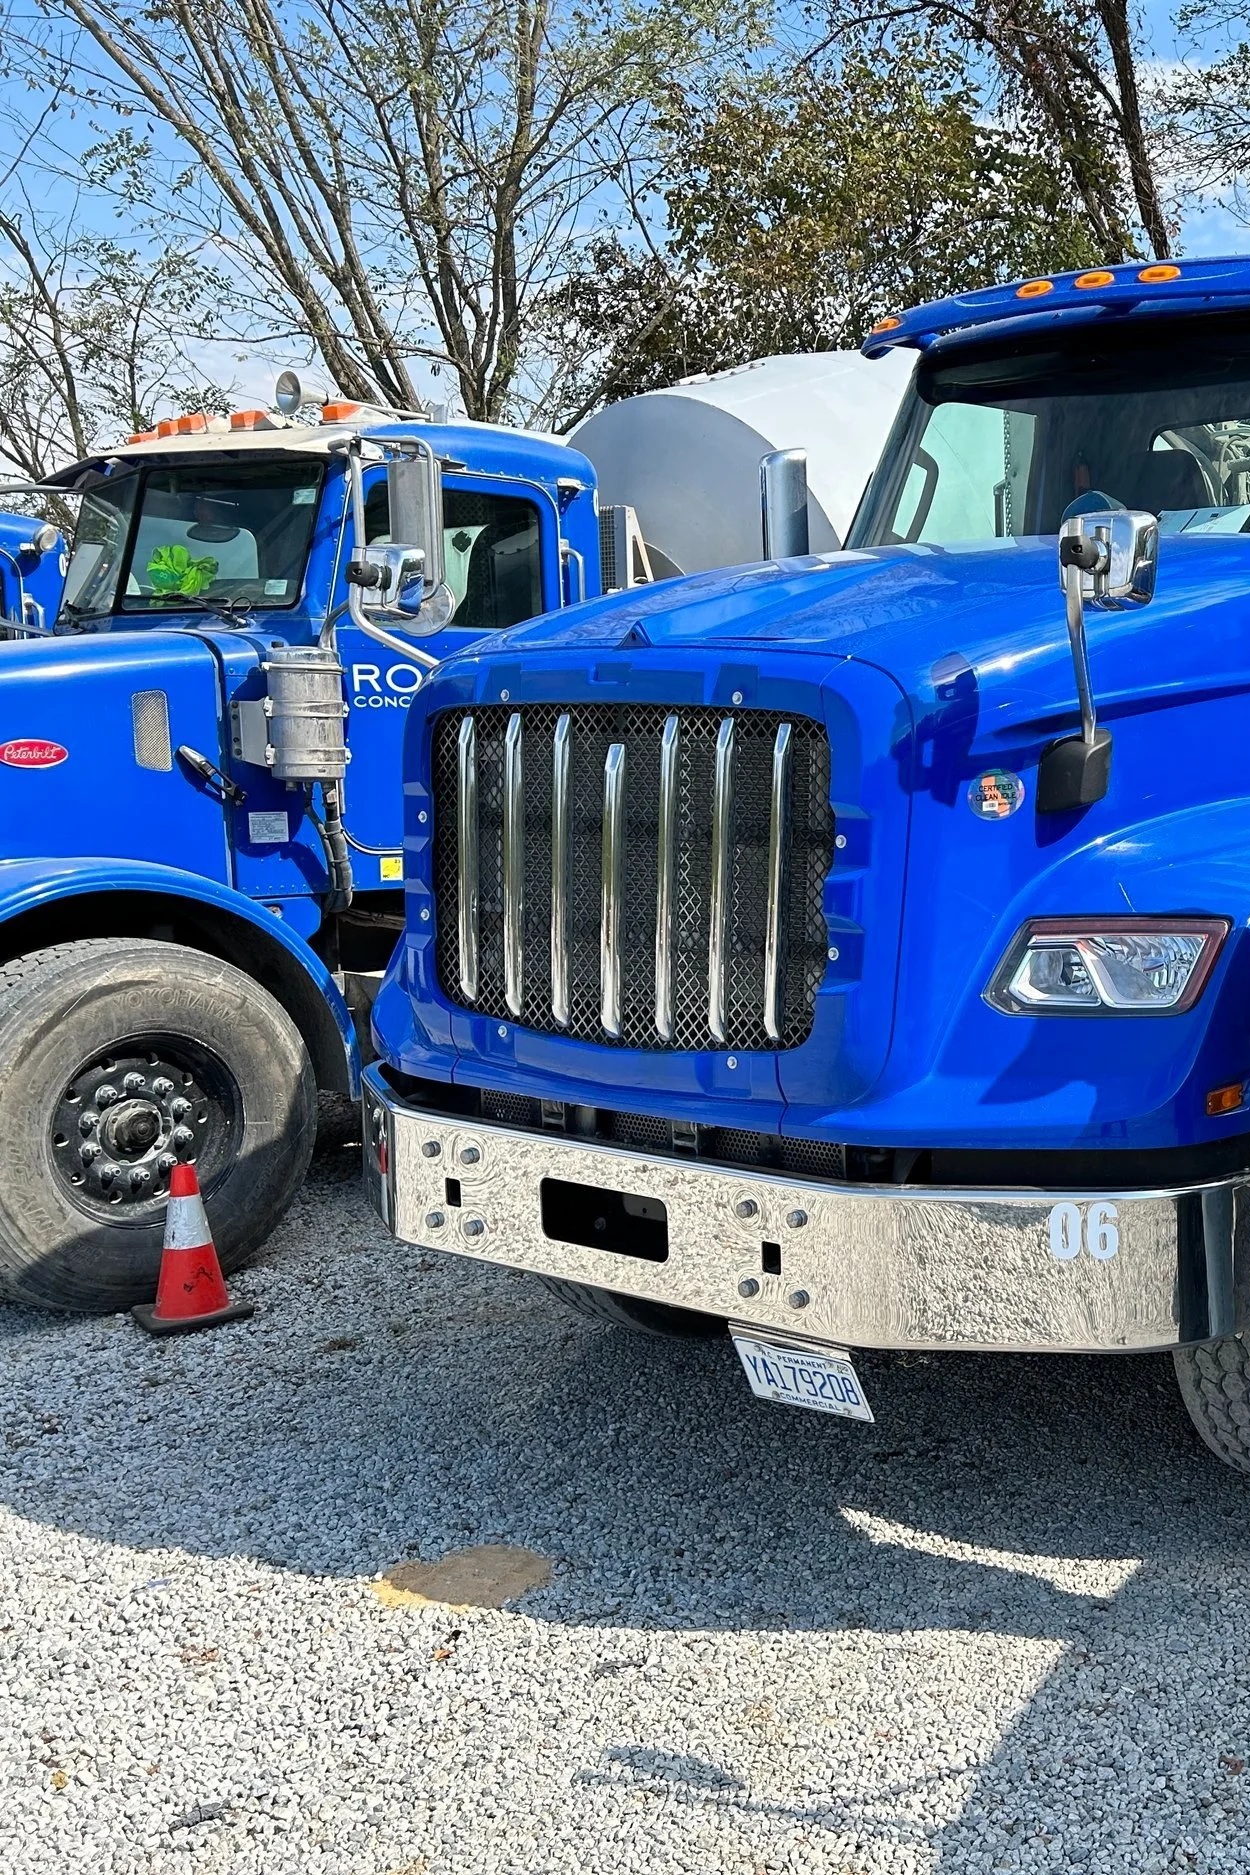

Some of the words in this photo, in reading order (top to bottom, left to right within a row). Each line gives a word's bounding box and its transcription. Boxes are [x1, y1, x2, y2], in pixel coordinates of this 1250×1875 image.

[3, 744, 61, 761] Peterbilt
[113, 986, 243, 1026] YOKOHAMA
[1050, 1202, 1119, 1260] 06
[777, 1355, 827, 1369] PERMANENT
[745, 1353, 861, 1406] YA179208
[779, 1393, 841, 1411] COMMERCIAL
